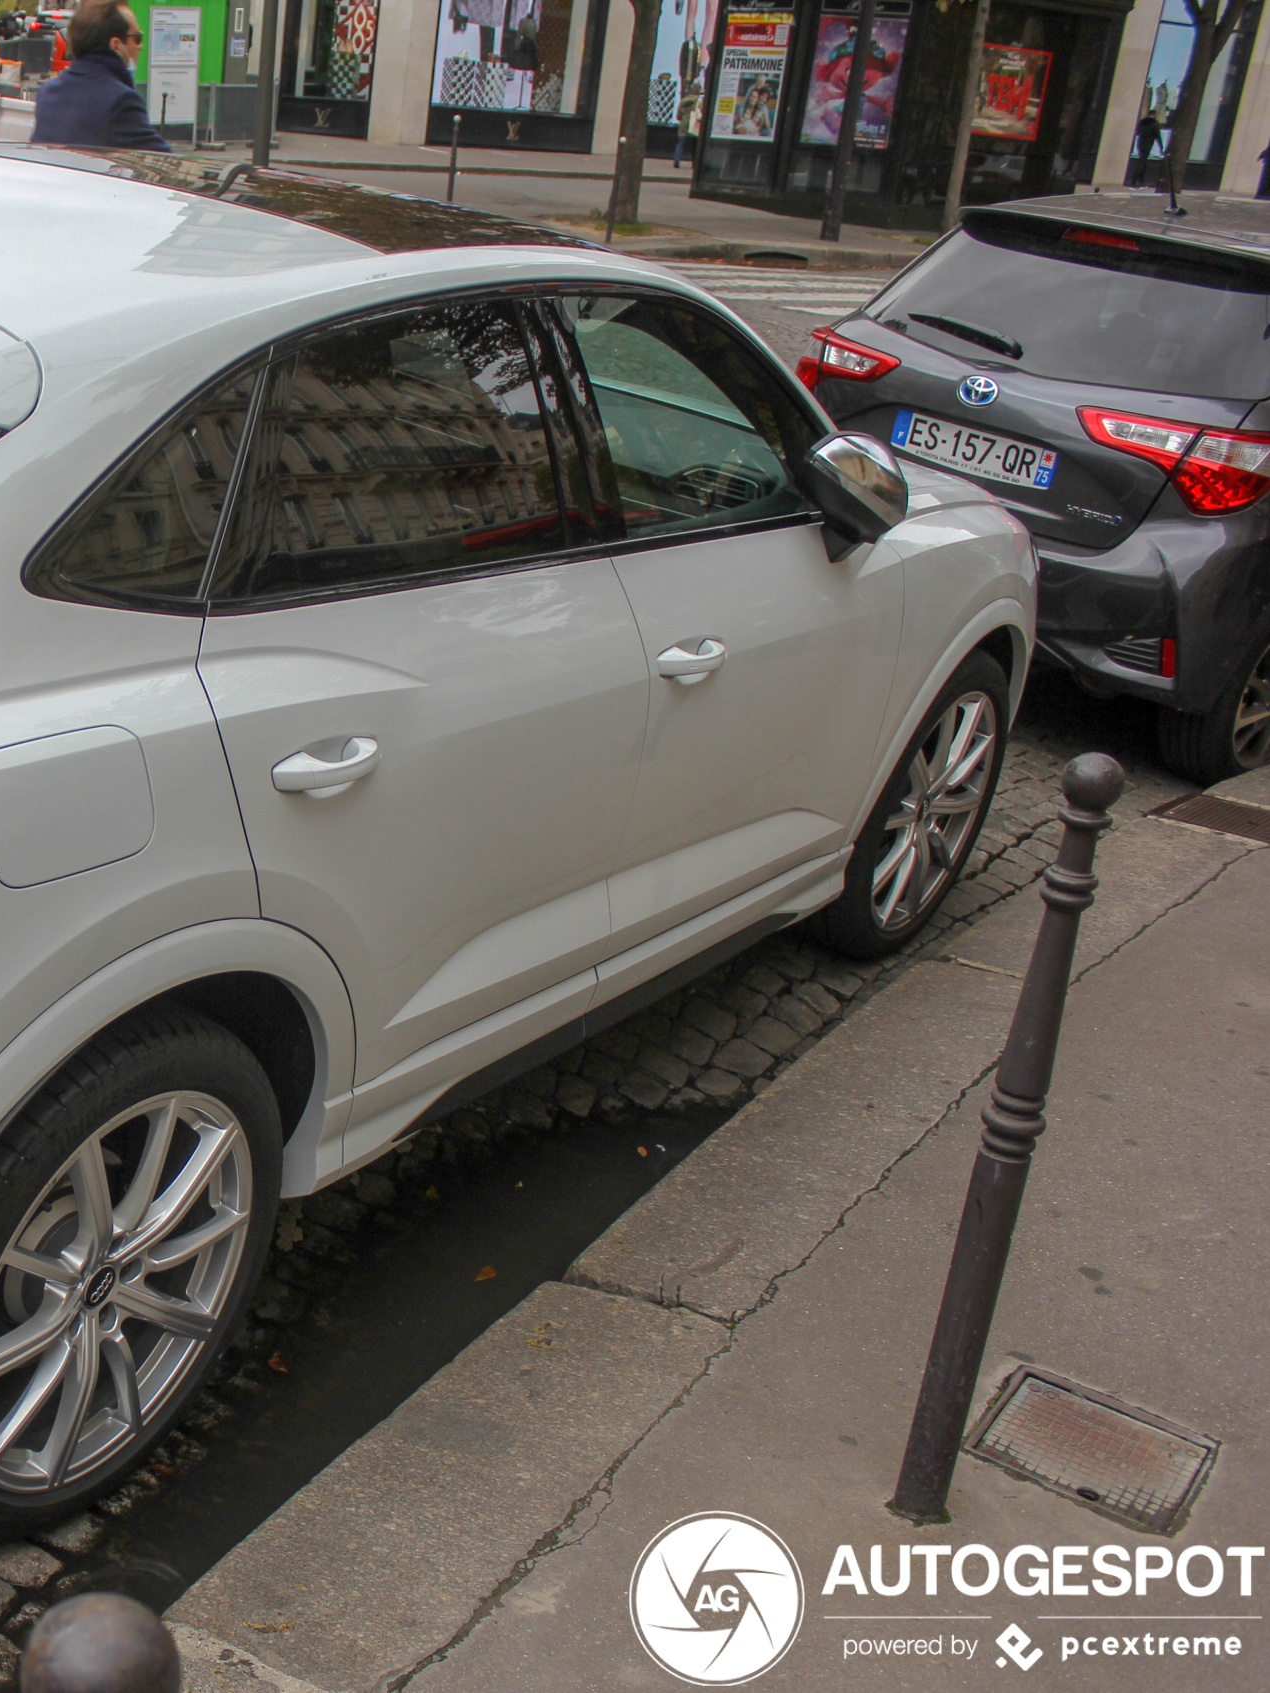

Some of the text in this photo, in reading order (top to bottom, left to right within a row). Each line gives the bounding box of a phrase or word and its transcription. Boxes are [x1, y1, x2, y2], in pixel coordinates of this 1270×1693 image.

[723, 57, 784, 71] PATRIMOINE
[897, 431, 905, 439] F
[908, 417, 1036, 479] ES-157-QR
[919, 450, 938, 460] TOYOTA
[939, 456, 959, 466] PARIS
[1036, 469, 1049, 483] 75
